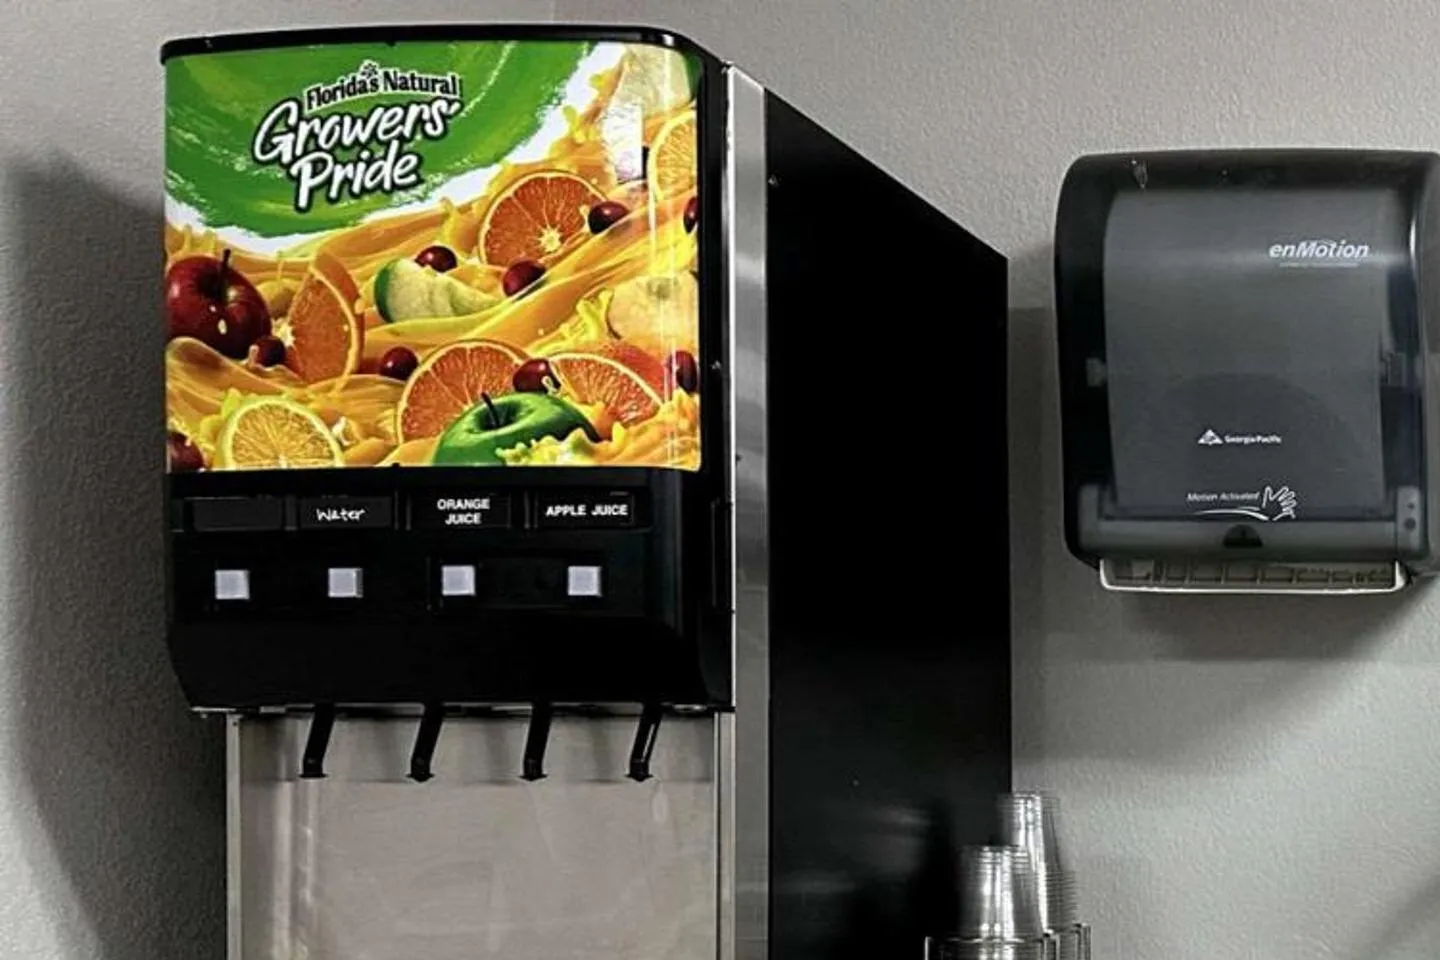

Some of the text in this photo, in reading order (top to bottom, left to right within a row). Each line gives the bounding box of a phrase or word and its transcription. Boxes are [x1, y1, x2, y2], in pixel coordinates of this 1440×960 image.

[306, 70, 458, 111] Florida's Natural
[290, 140, 419, 209] Pride
[1268, 239, 1370, 258] enMotion
[1187, 492, 1260, 501] Motion Activated
[437, 498, 490, 510] ORANGE
[545, 504, 628, 516] APPLE JUICE
[316, 507, 367, 522] Water
[445, 512, 482, 525] JUICE
